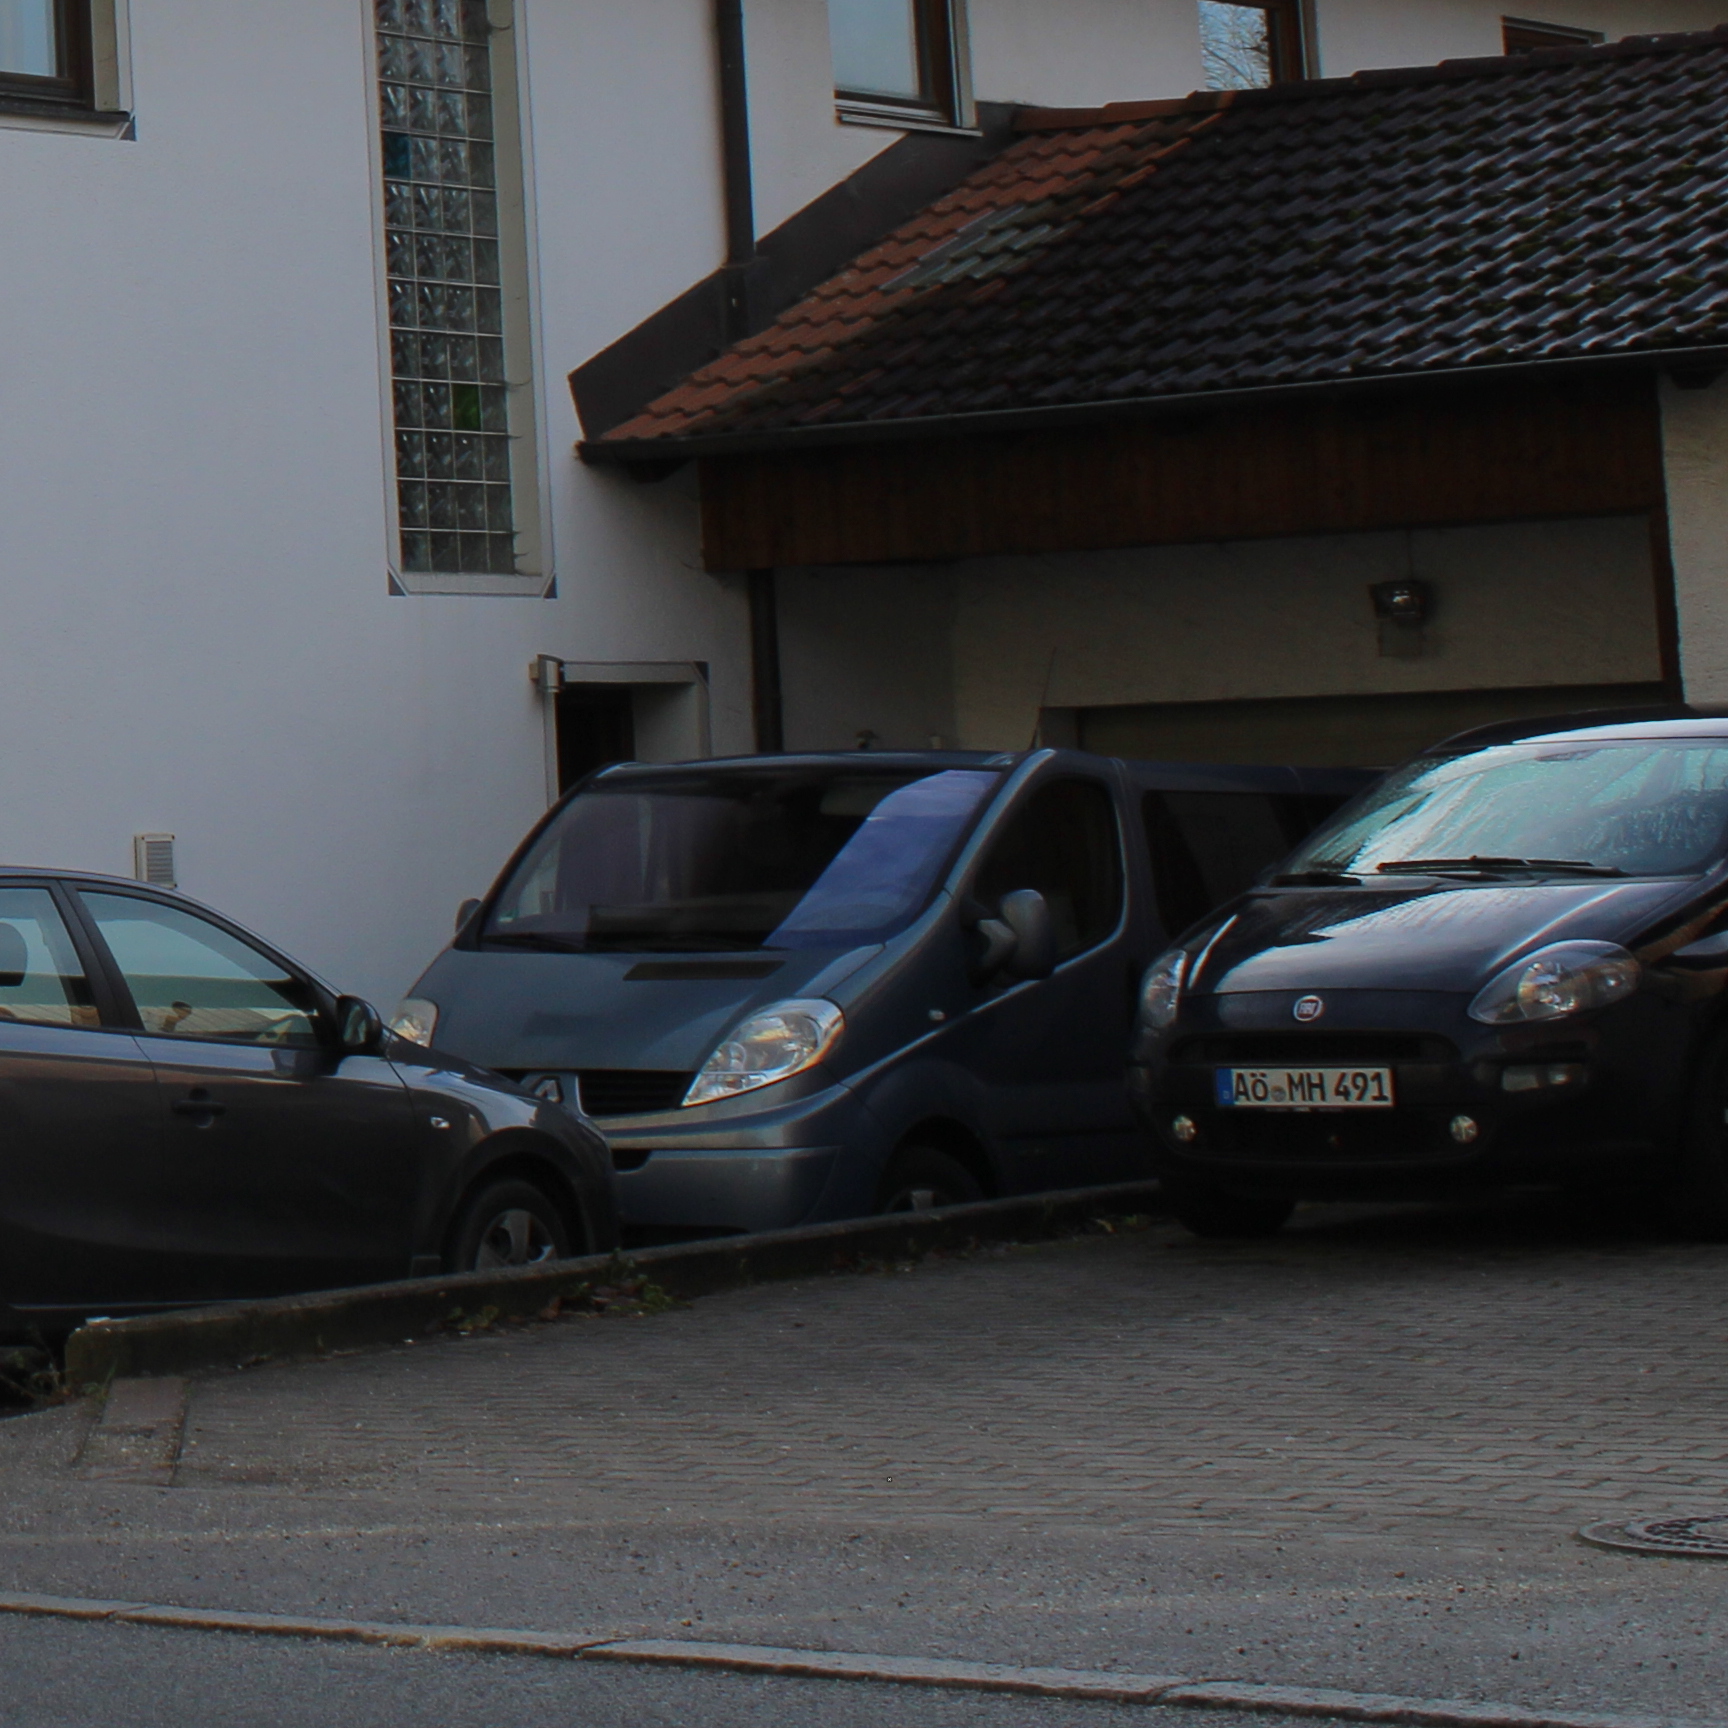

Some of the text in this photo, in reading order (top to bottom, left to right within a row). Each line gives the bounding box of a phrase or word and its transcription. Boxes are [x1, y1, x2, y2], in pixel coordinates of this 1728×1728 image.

[1234, 1072, 1389, 1101] AÖ MH 491
